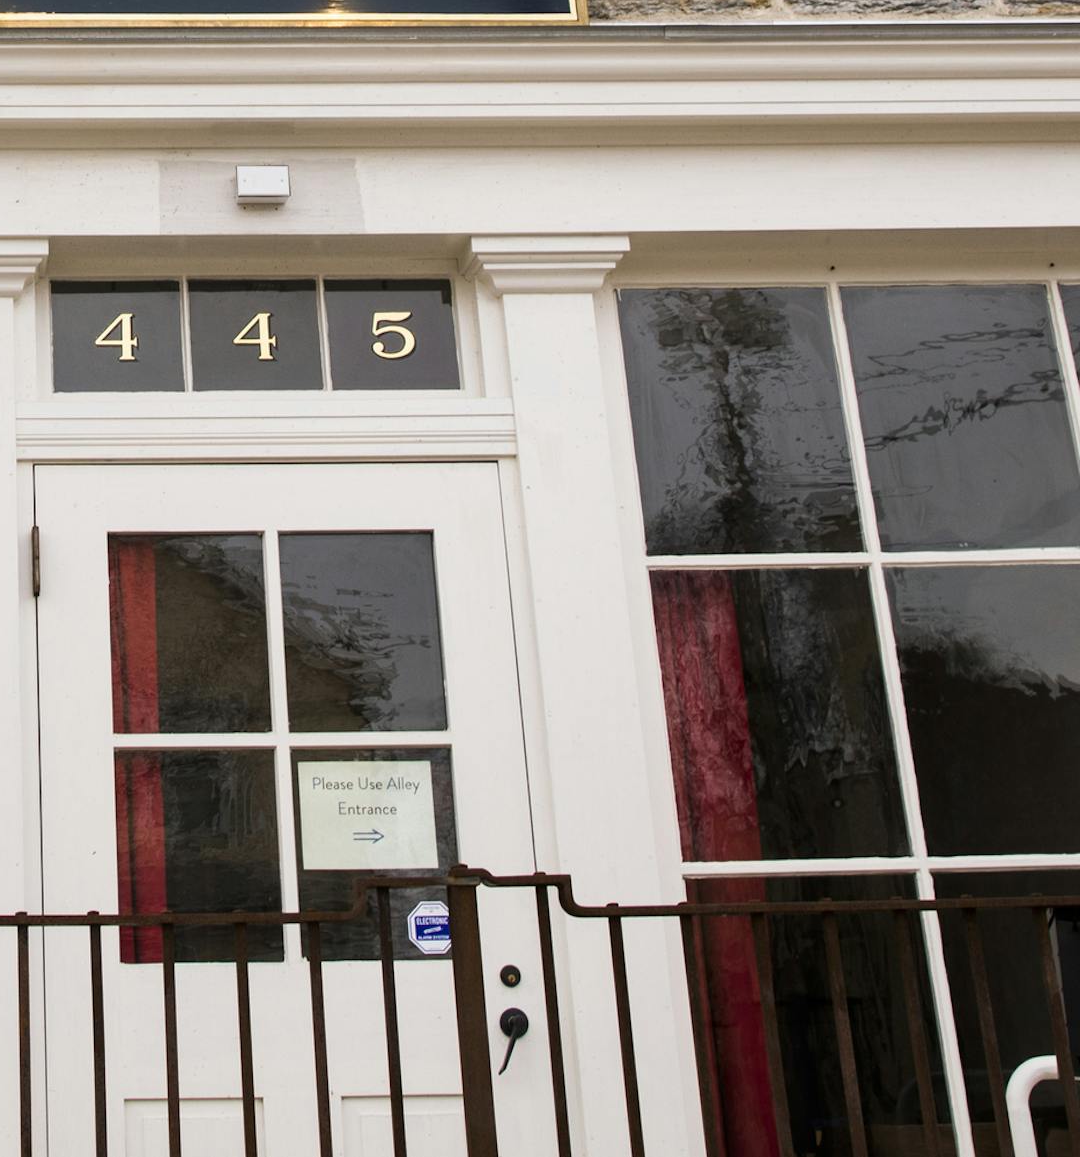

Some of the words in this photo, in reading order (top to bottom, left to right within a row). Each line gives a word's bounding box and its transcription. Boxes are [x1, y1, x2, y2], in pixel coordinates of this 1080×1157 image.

[312, 777, 354, 791] Please
[358, 777, 383, 790] Use
[386, 777, 420, 794] Alley
[338, 801, 397, 815] Entrance
[415, 917, 449, 925] ELECTRONIC
